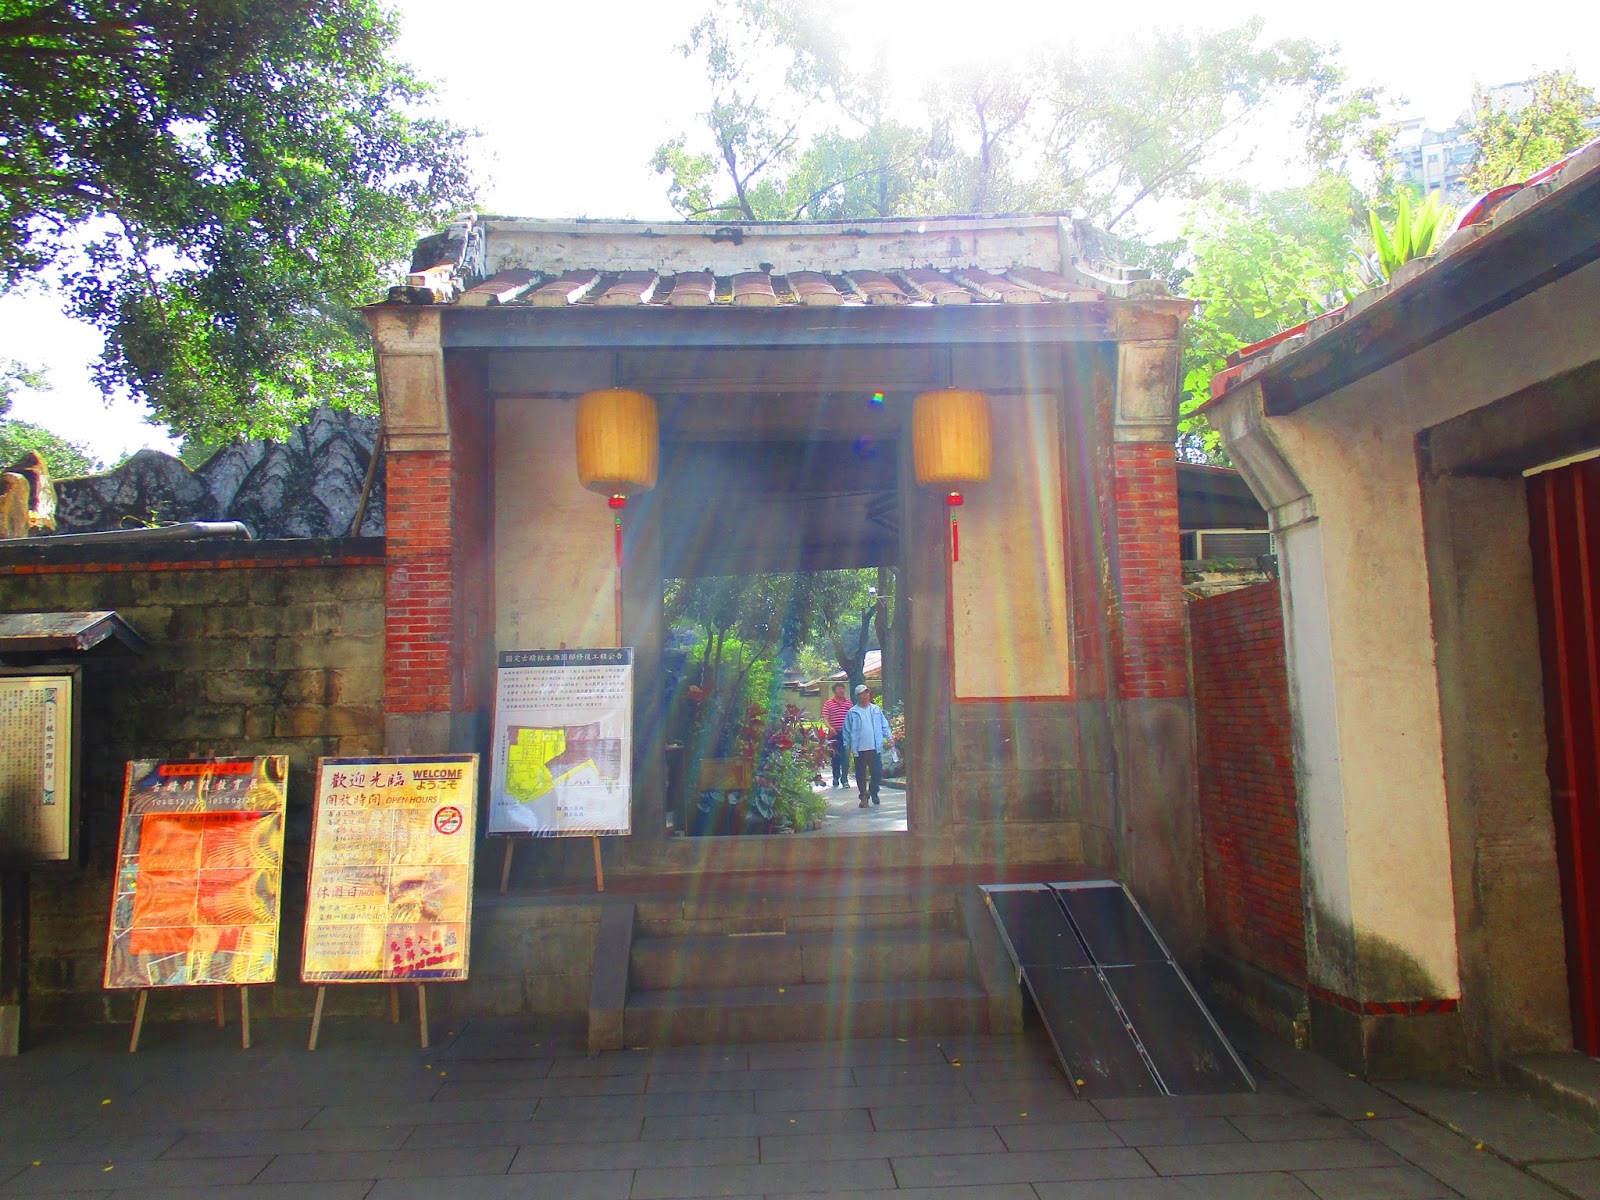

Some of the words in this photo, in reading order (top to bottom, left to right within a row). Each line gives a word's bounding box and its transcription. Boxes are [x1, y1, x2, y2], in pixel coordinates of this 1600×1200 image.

[413, 769, 462, 779] WELCOME
[151, 778, 259, 792] 古蹟修復教育展
[330, 771, 405, 789] 歡迎光臨
[416, 780, 458, 790] ようこそ
[325, 794, 381, 806] 開放時間
[386, 796, 410, 804] OPEN
[410, 796, 438, 804] HOURS
